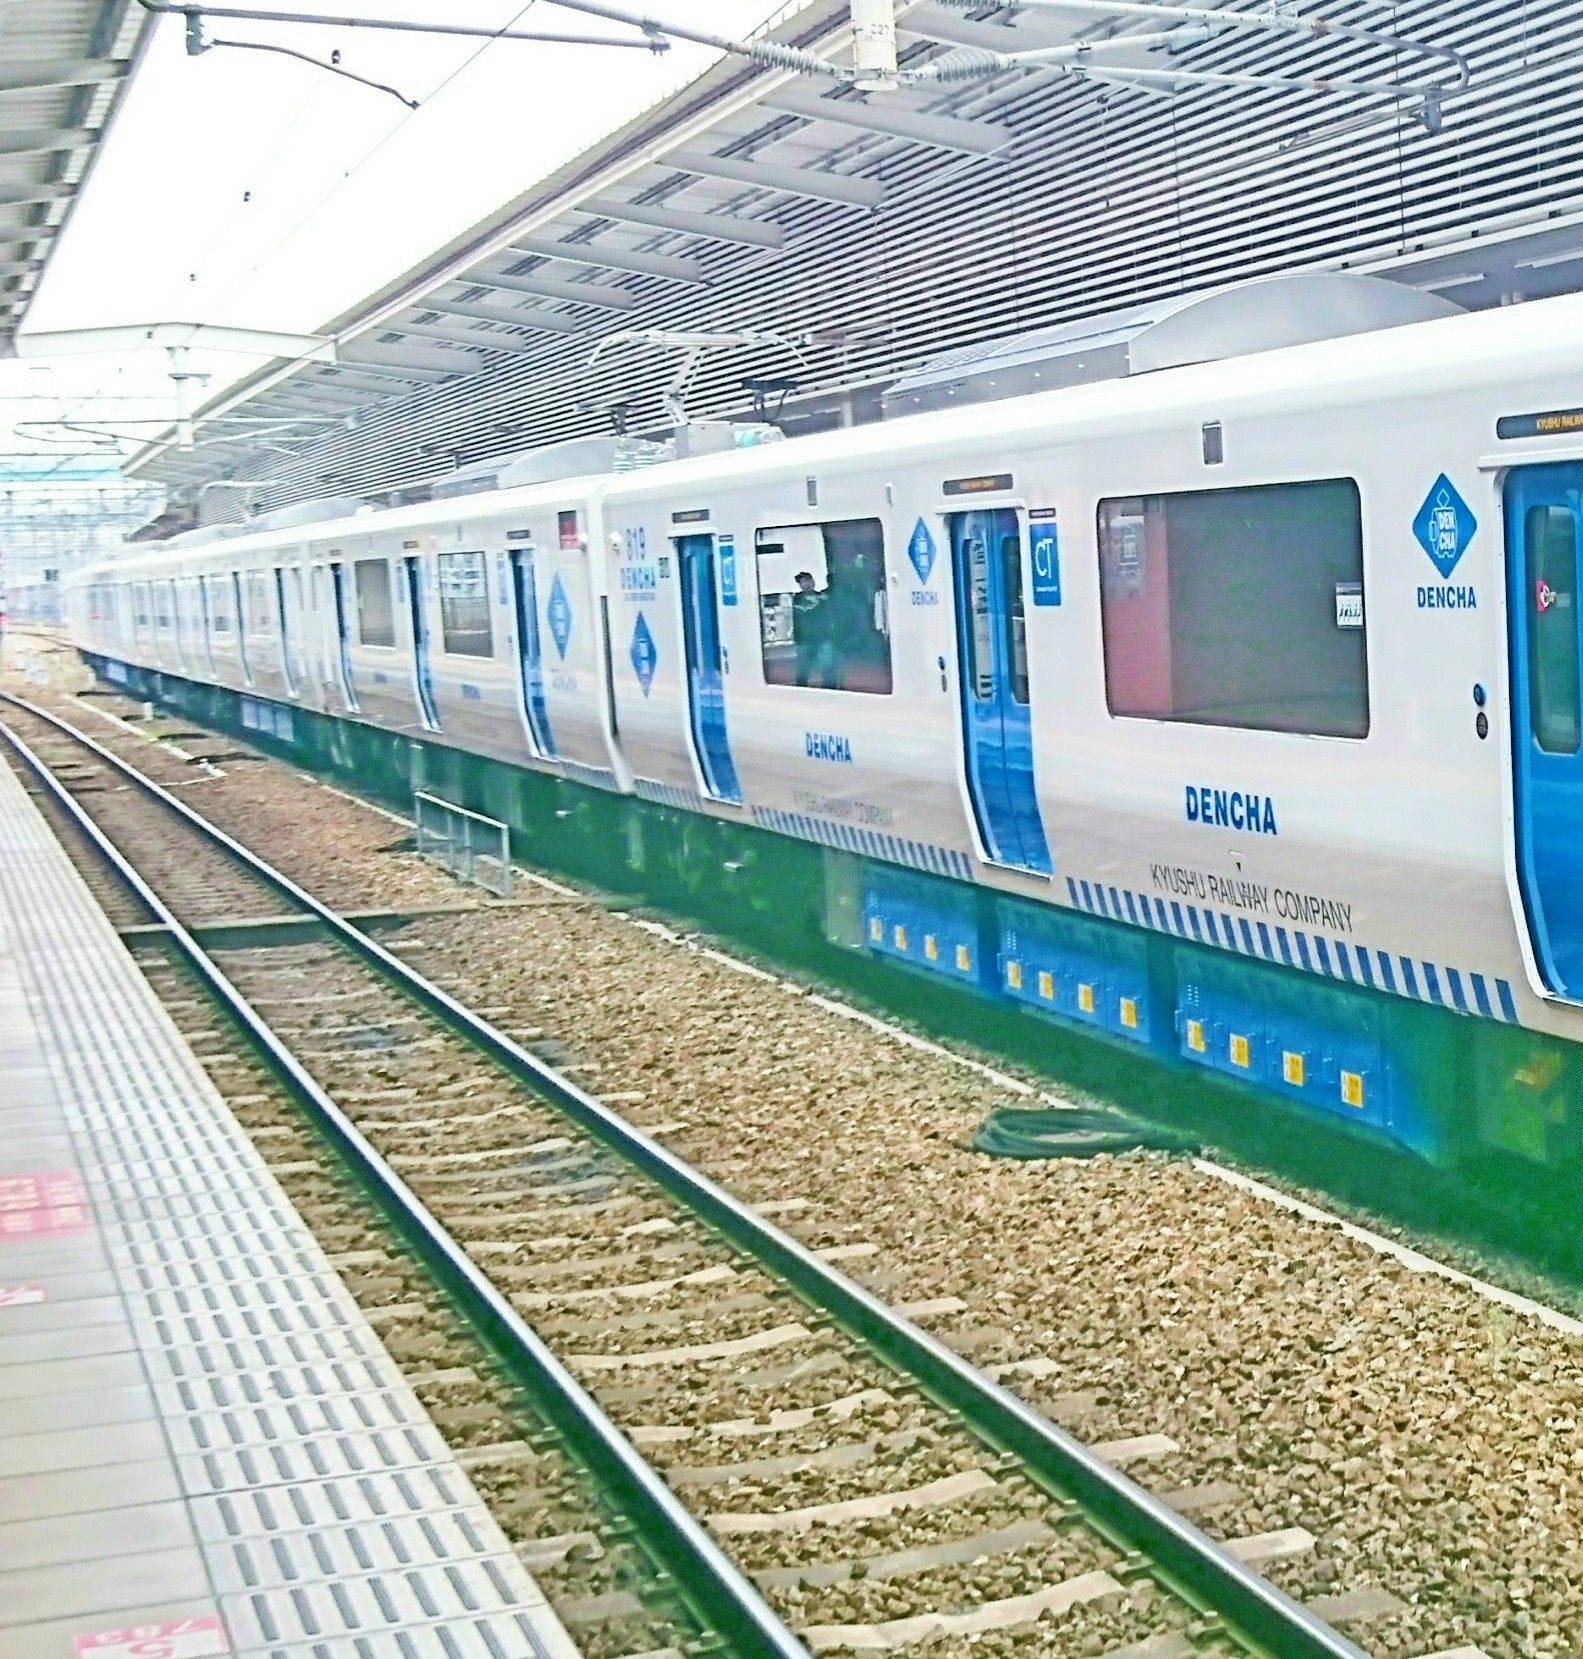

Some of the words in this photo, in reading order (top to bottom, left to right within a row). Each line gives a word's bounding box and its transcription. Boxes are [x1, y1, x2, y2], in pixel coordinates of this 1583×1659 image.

[1536, 416, 1560, 430] KYUSHU
[1035, 537, 1054, 579] CT
[1417, 586, 1477, 609] DENCHA
[805, 732, 852, 764] DENCHA
[1186, 786, 1277, 835] DENCHA
[1149, 863, 1206, 900] KYUSHU
[1208, 875, 1268, 915] RAILWAY
[1274, 888, 1353, 933] COMPANY
